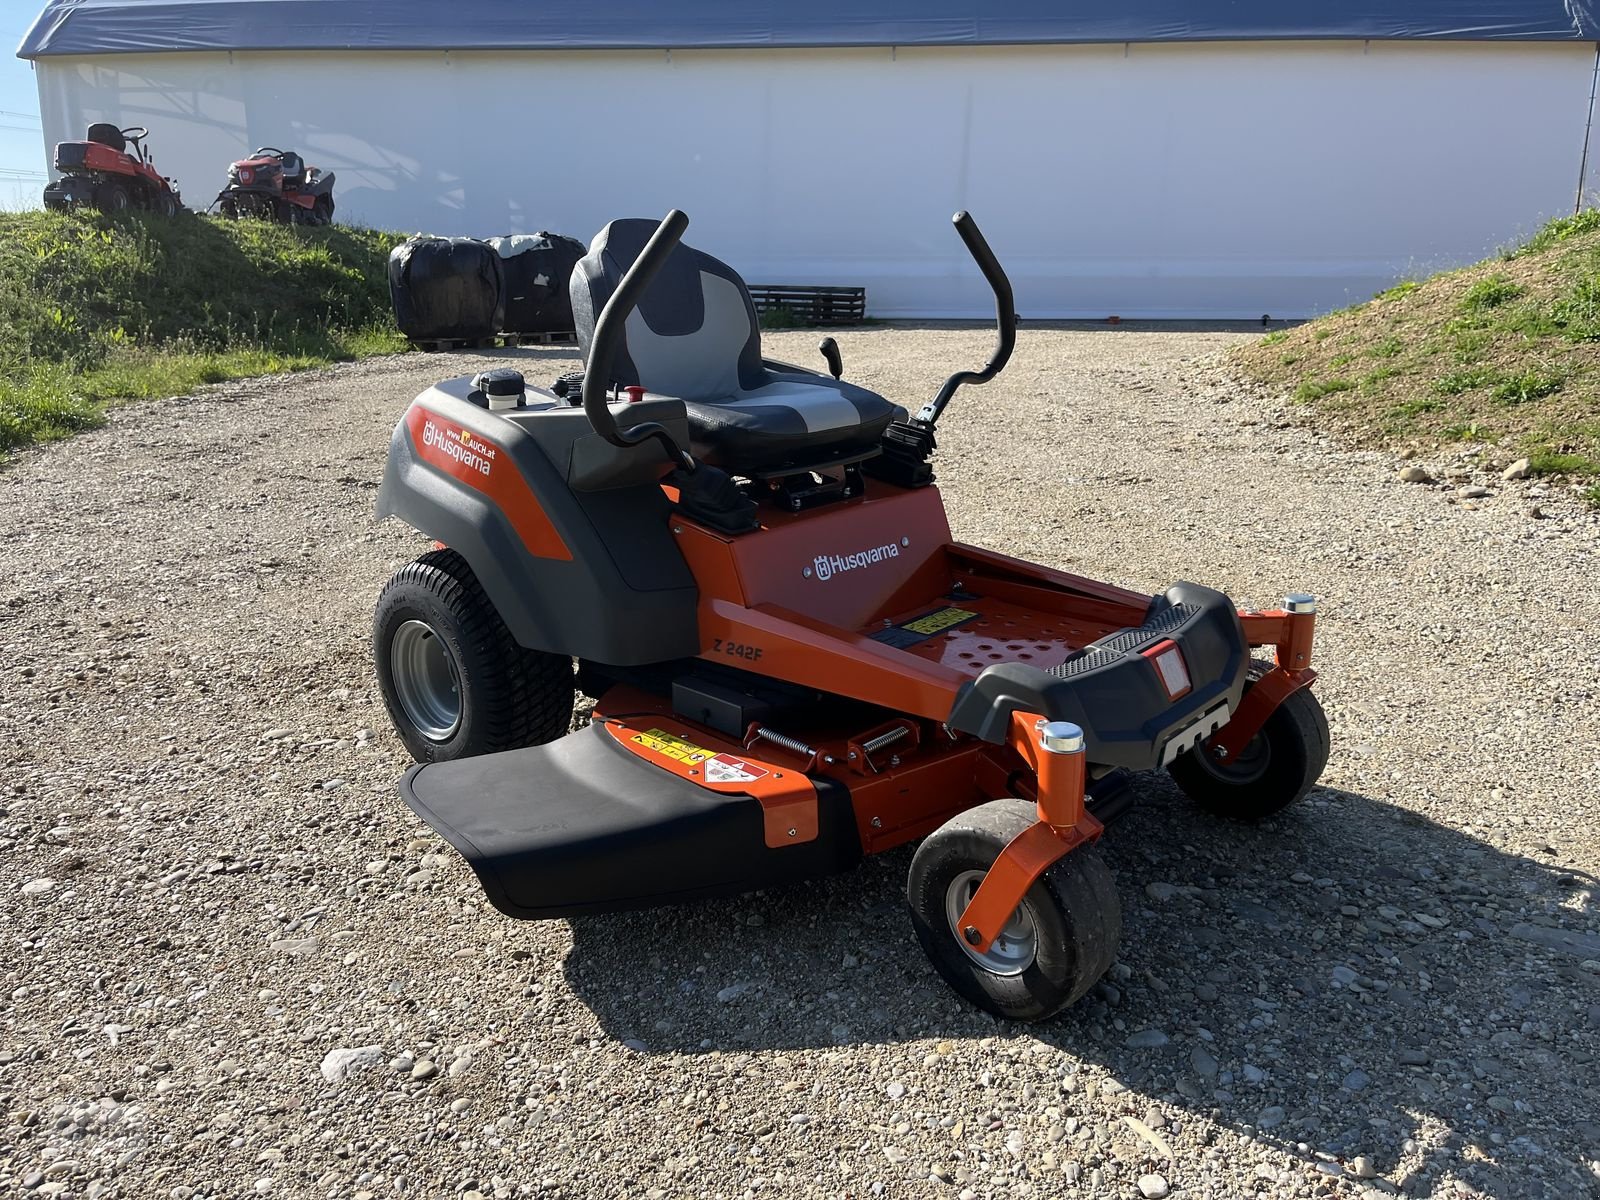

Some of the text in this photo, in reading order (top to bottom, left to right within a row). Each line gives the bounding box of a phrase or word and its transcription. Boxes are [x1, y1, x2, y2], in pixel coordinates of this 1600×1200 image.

[433, 429, 491, 476] Husqvarna
[829, 543, 899, 574] Husqvarna
[713, 638, 763, 661] Z 242F
